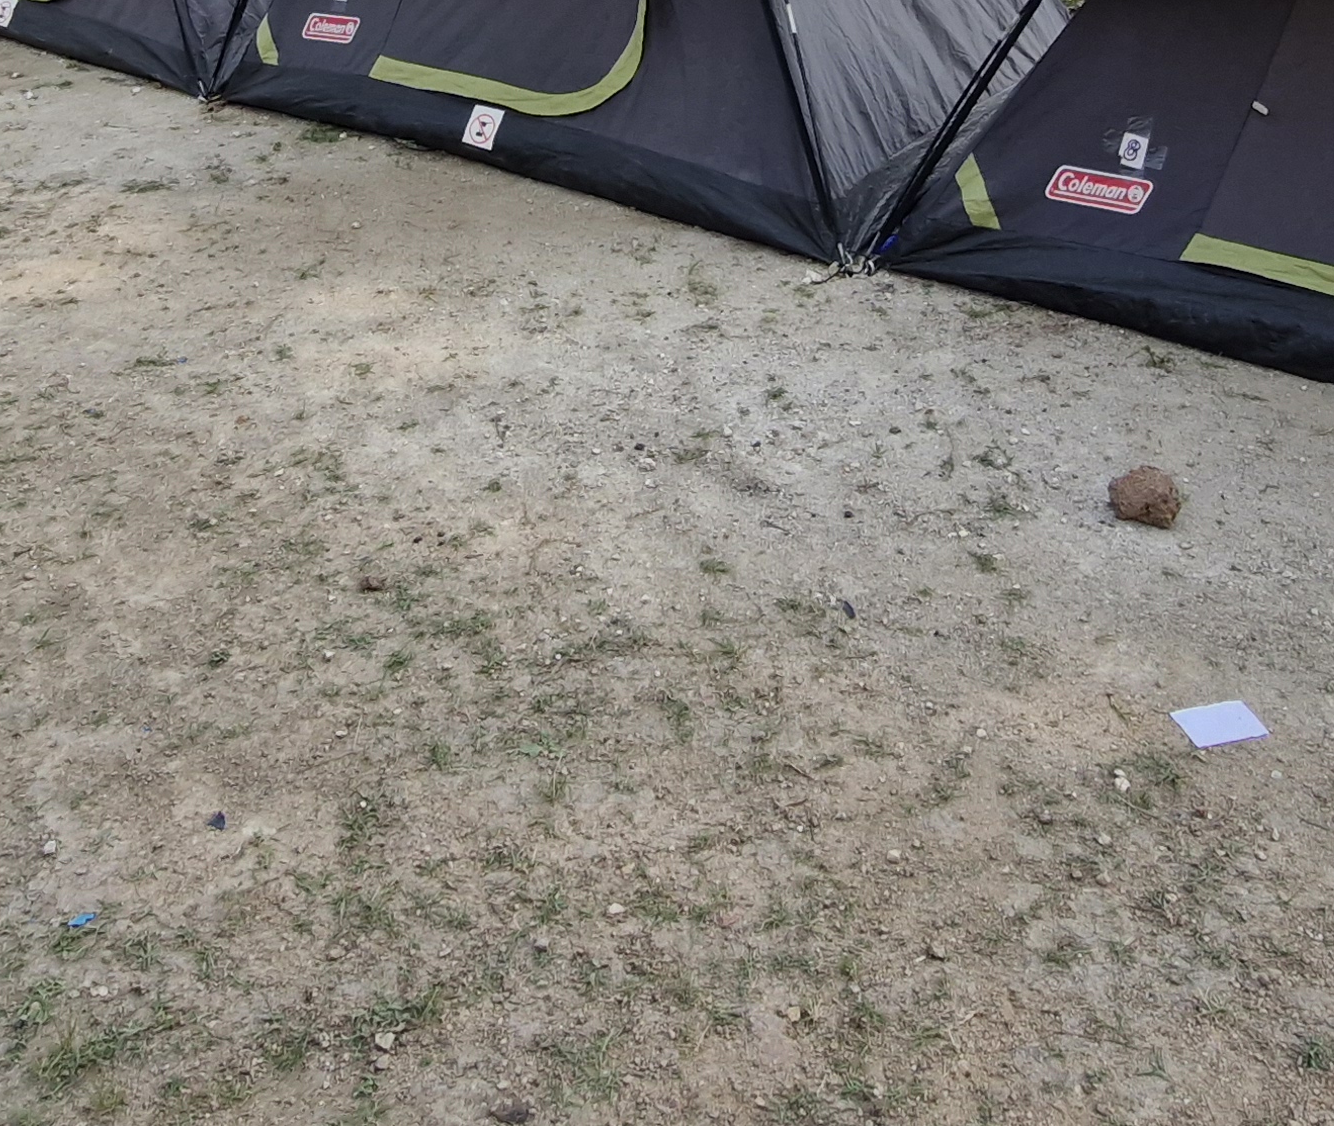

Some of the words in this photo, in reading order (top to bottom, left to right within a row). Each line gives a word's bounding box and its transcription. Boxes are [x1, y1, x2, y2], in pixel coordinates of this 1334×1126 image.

[310, 18, 345, 34] Coleman
[1123, 139, 1141, 162] 8
[1058, 172, 1127, 200] Coleman
